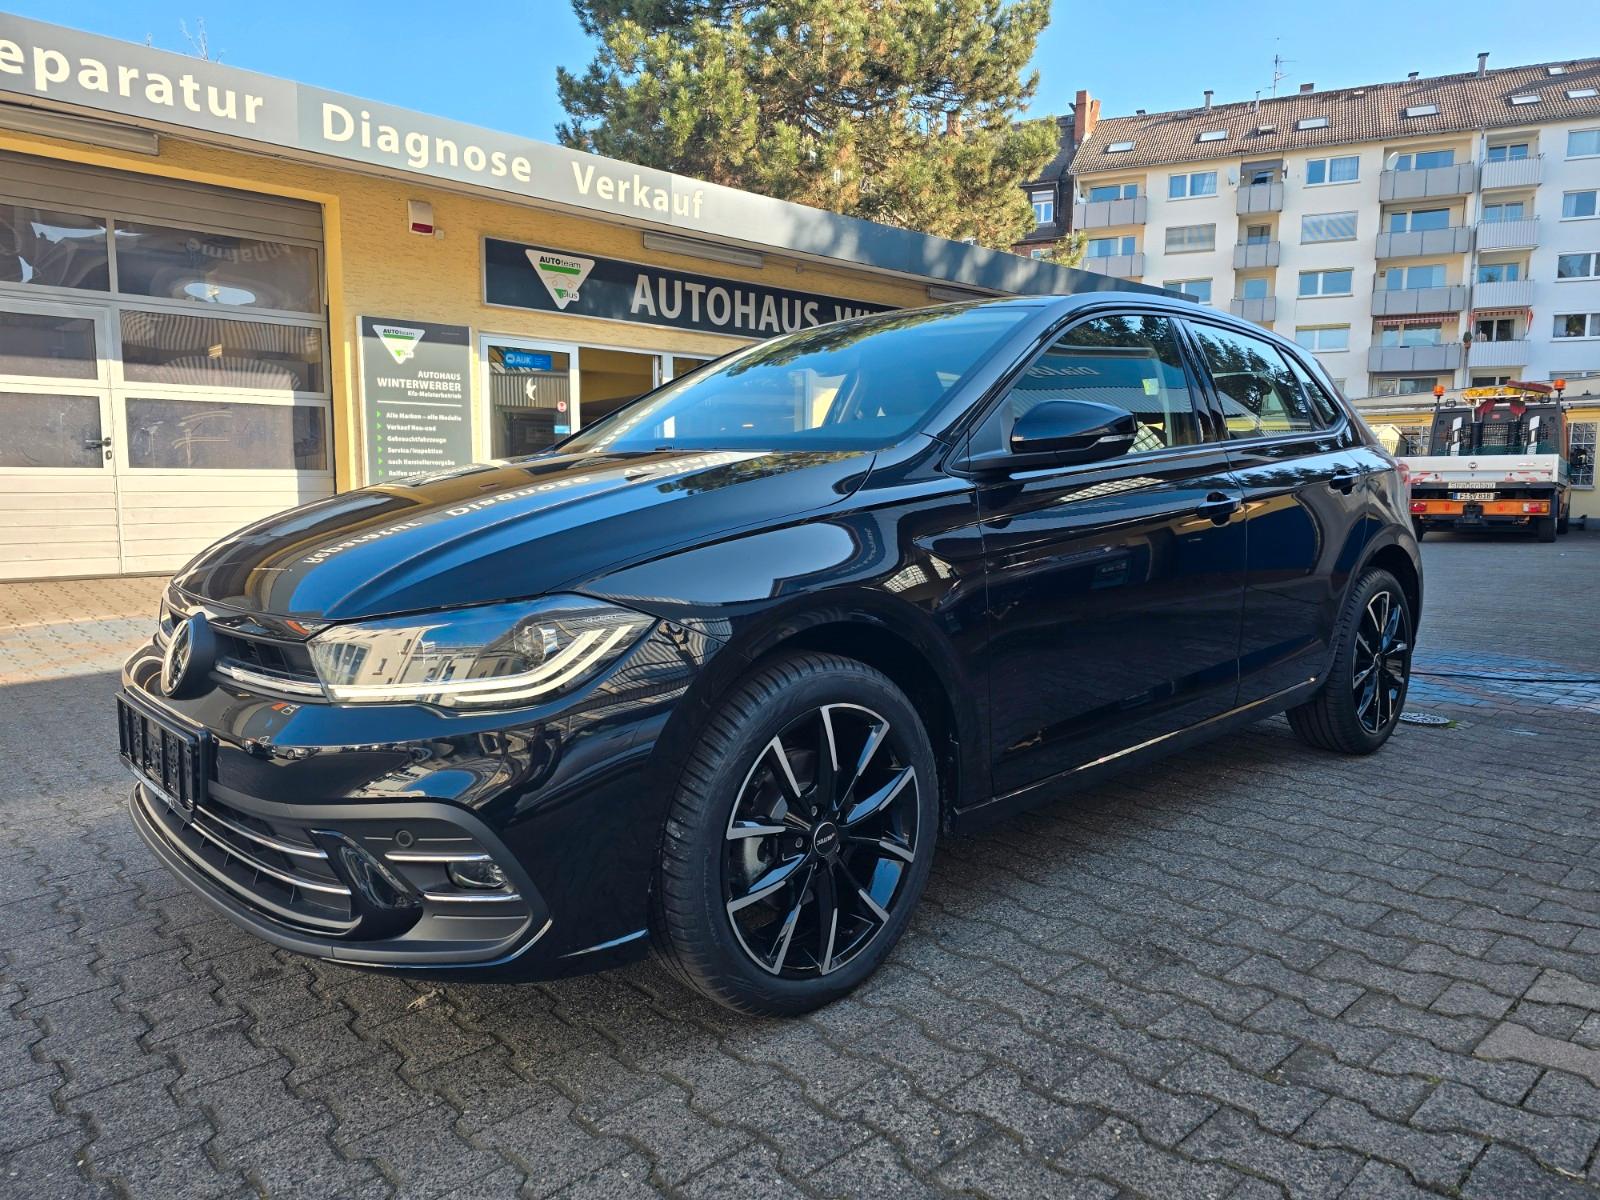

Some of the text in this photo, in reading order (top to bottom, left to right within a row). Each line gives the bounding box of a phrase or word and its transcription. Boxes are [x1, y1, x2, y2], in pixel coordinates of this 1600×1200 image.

[0, 39, 703, 219] eparatur Diagnose Verkauf
[540, 256, 581, 269] AUTOteam
[630, 274, 819, 334] AUTOHAUS
[418, 370, 461, 381] AUTOHAUS
[376, 377, 462, 392] WINTERWERBER
